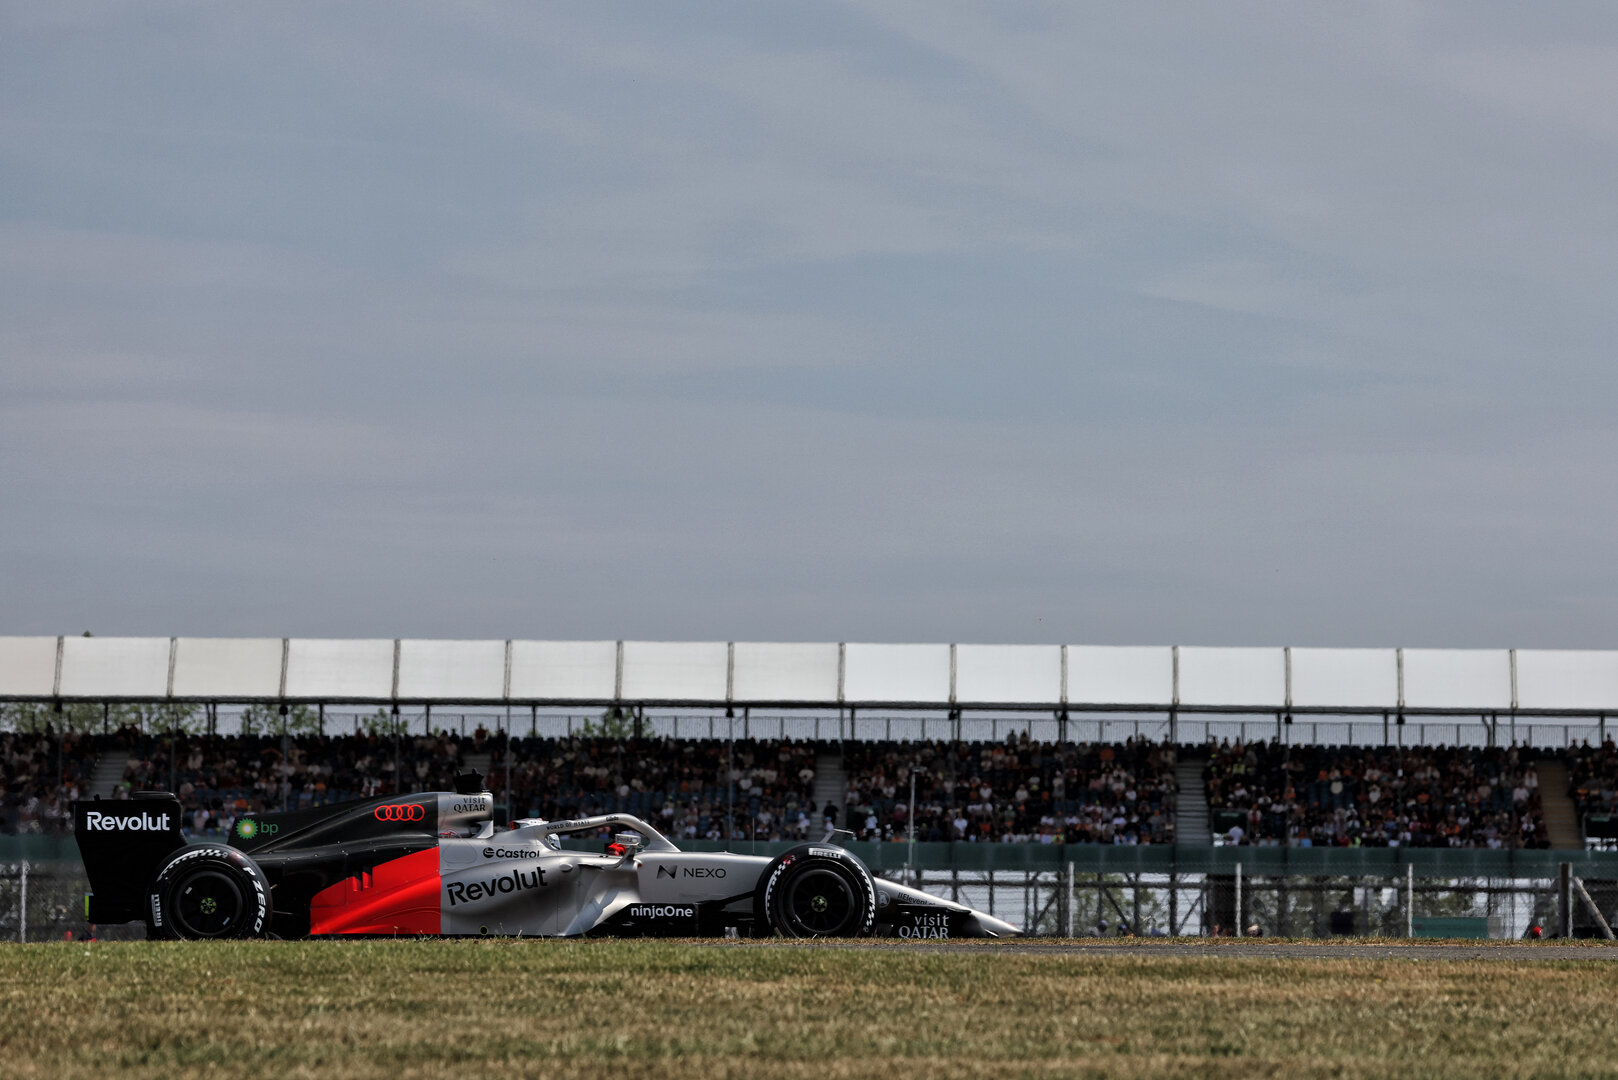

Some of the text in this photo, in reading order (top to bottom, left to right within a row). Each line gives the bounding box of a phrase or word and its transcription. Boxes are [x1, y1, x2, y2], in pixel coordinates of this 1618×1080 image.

[453, 803, 486, 813] QATAR
[87, 811, 170, 831] Revolut
[260, 821, 279, 836] bp
[496, 848, 540, 858] Castrol
[808, 847, 846, 859] PIRELLI
[683, 868, 727, 878] NEXO
[446, 866, 548, 906] Revolut
[242, 866, 266, 934] P ZERO
[151, 894, 163, 928] PIRELLI
[630, 905, 694, 919] ninjaOne
[914, 913, 950, 927] visit
[898, 925, 950, 940] QATAR
